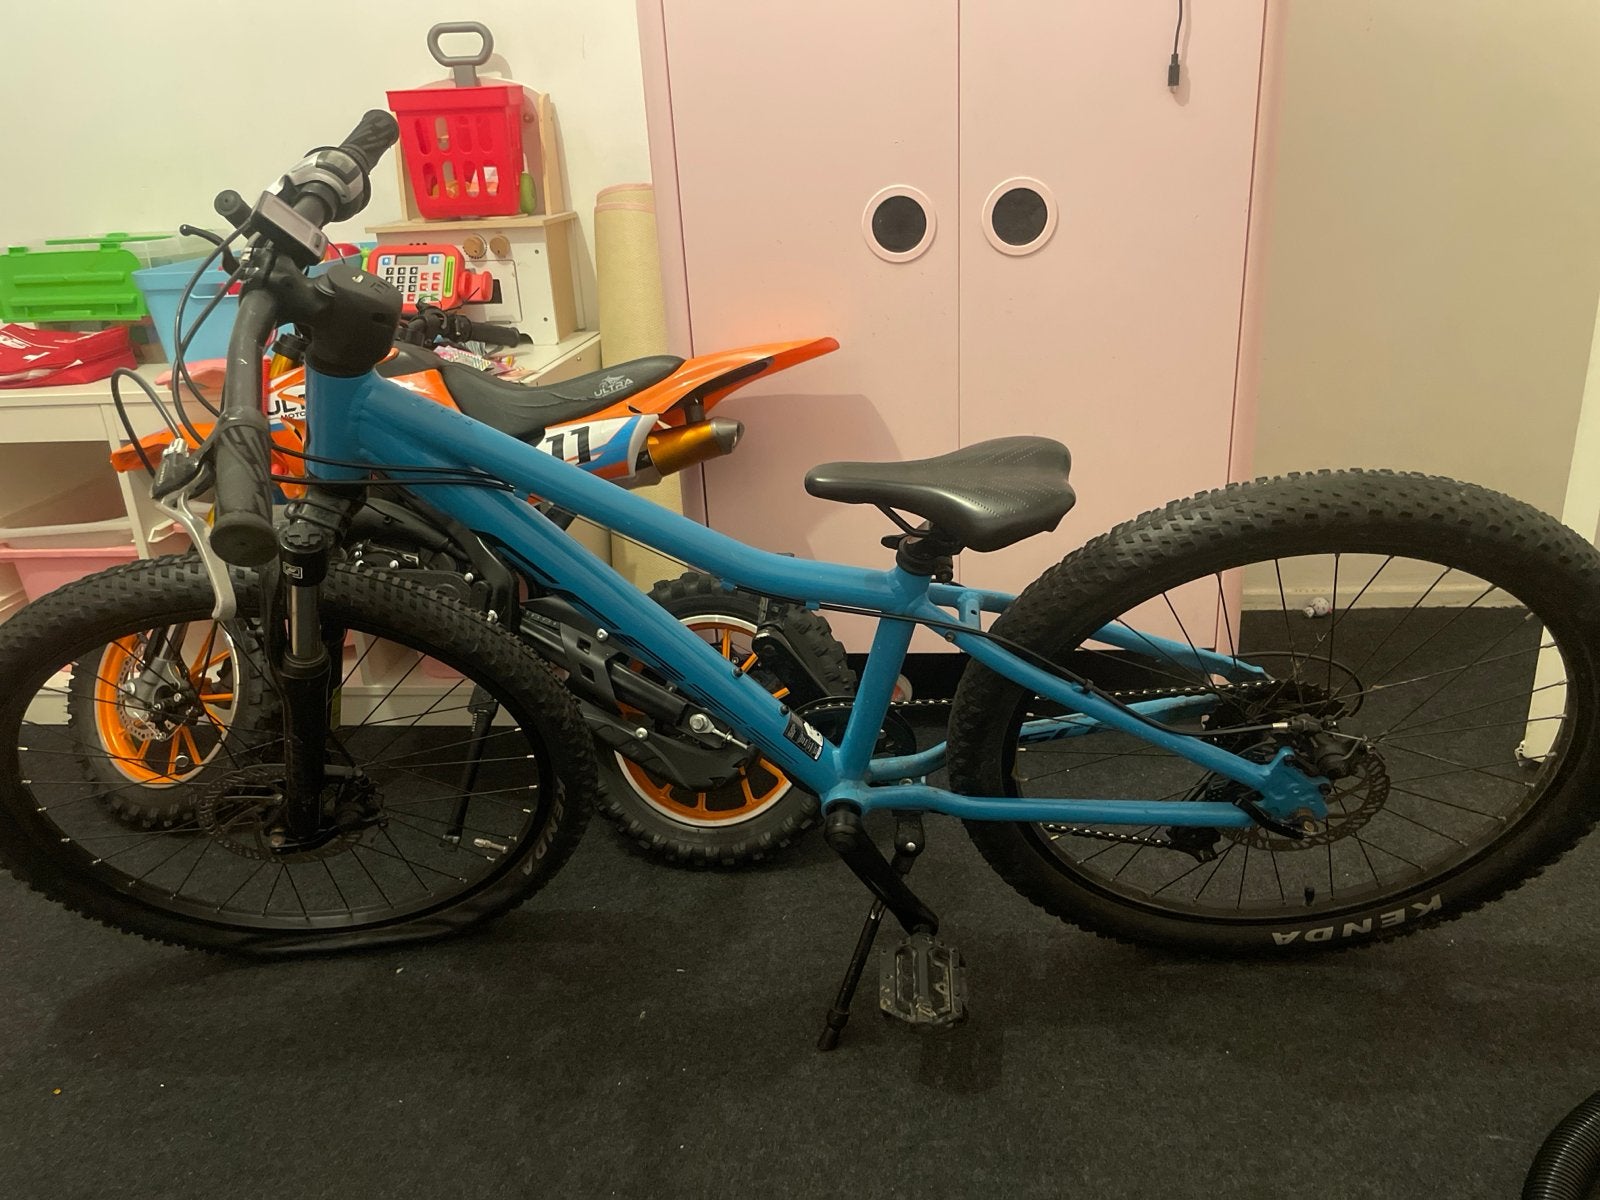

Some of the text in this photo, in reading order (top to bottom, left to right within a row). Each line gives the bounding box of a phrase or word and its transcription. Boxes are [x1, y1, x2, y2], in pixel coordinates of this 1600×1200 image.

[593, 378, 634, 397] ULTRA
[545, 425, 591, 466] 11
[1271, 894, 1443, 946] KENDA
